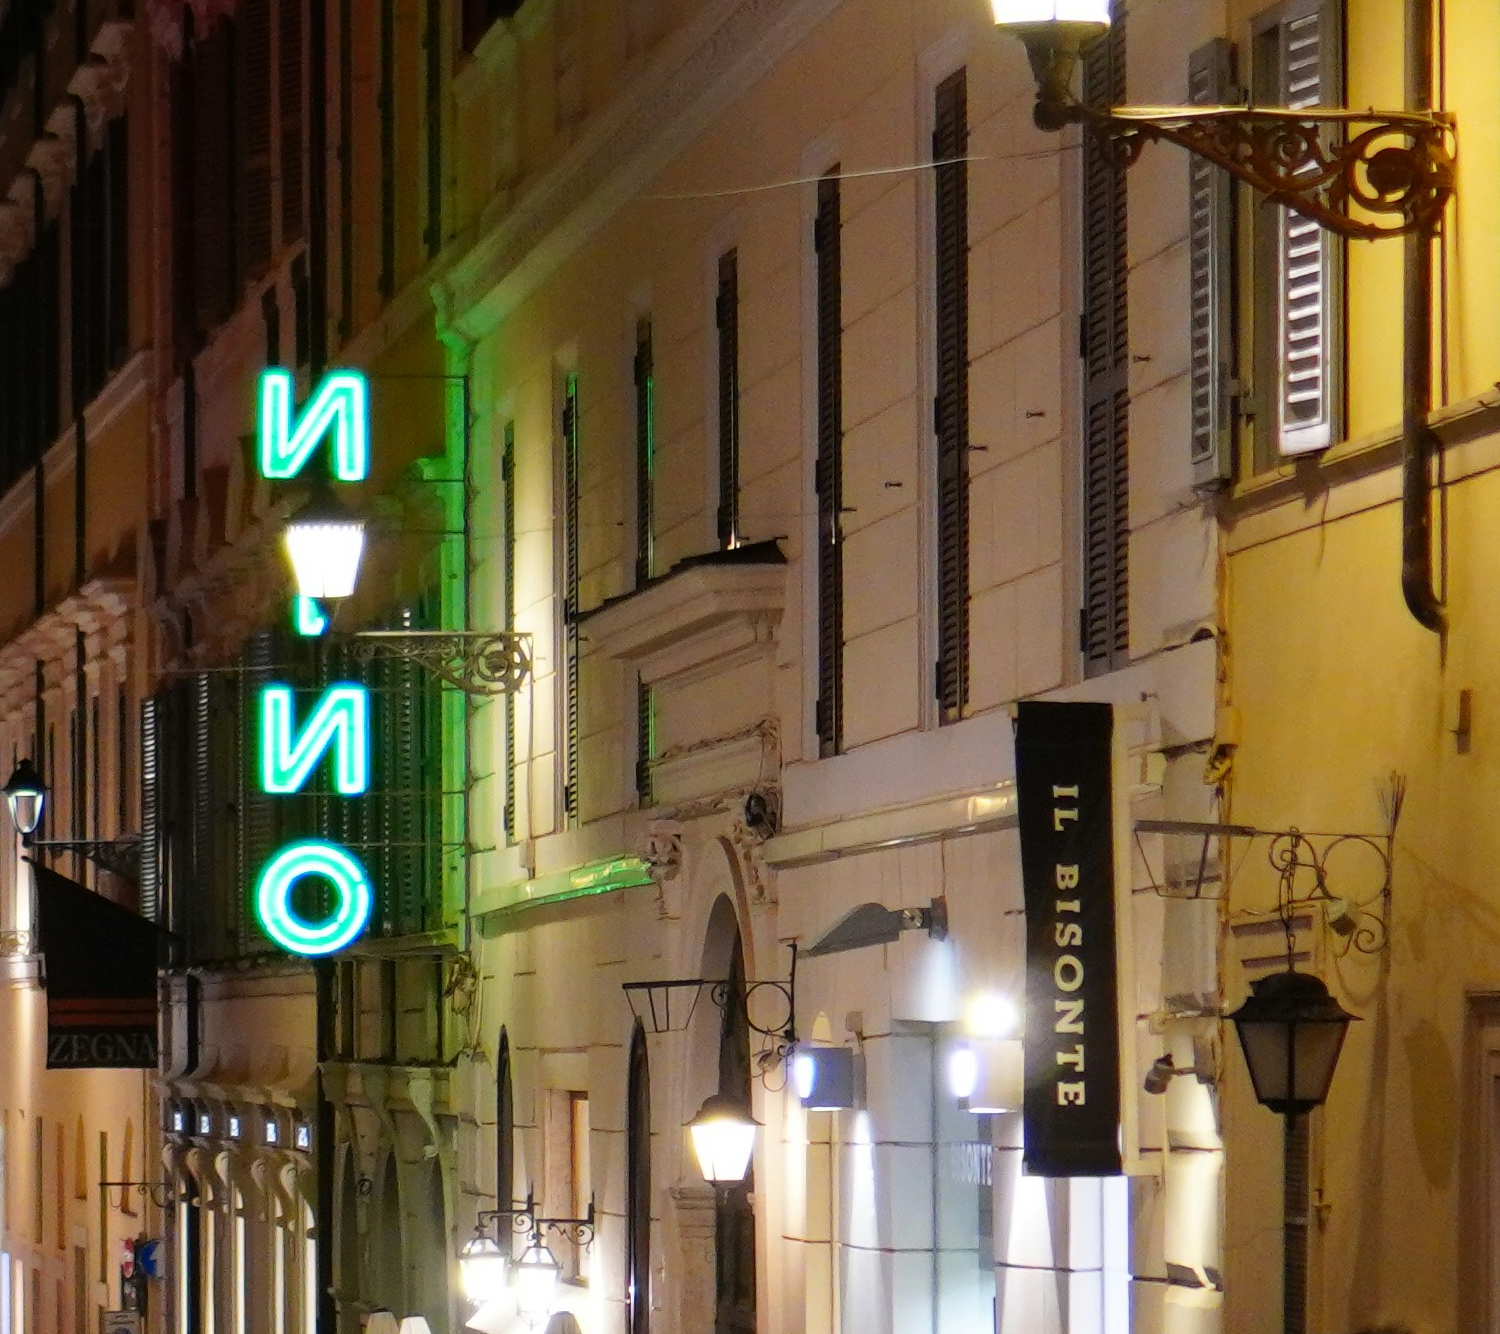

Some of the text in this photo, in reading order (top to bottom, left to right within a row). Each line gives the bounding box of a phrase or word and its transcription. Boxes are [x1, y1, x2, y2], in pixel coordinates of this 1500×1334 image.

[1052, 784, 1086, 1108] IL BISONTE
[50, 1033, 157, 1063] ZEGNA
